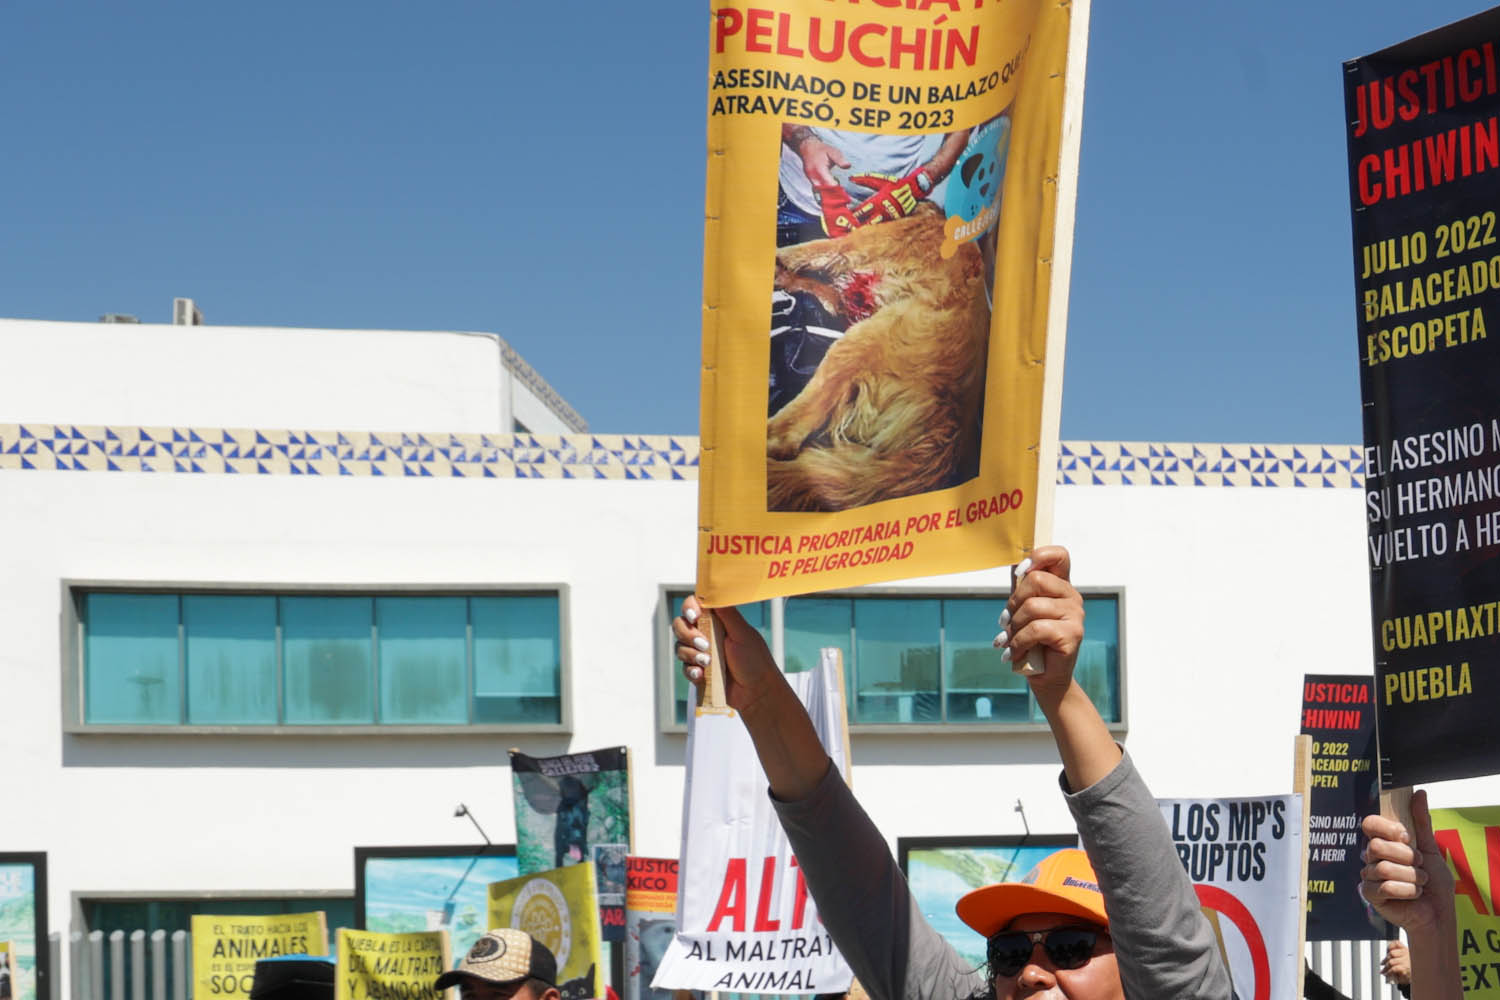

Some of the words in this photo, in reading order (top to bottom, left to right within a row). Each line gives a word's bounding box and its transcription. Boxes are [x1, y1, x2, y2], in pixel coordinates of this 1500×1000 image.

[715, 8, 980, 71] PELUCHÍN
[712, 69, 846, 99] ASESINADO
[852, 82, 881, 102] DE
[888, 85, 921, 105] UN
[927, 71, 999, 105] BALAZO
[712, 95, 841, 127] ATRAVESÓ,
[848, 107, 891, 129] SEP
[898, 109, 955, 130] 2023
[1362, 231, 1428, 280] JULIO
[1435, 210, 1497, 260] 2022
[1368, 306, 1488, 367] ESCOPETA
[1364, 445, 1386, 479] EL
[1390, 423, 1485, 473] ASESINO
[706, 534, 793, 556] JUSTICIA
[797, 520, 902, 554] PRIORITARIA
[904, 511, 941, 537] POR
[945, 508, 963, 530] EL
[965, 487, 1025, 524] GRADO
[1367, 487, 1391, 523] SU
[767, 560, 790, 580] DE
[792, 540, 914, 577] PELIGROSIDAD
[1369, 522, 1448, 567] VUELTO
[1455, 518, 1470, 553] A
[1304, 682, 1369, 705] USTICIA
[1385, 661, 1473, 706] PUEBLA
[1322, 742, 1350, 756] 2022
[1351, 759, 1371, 772] CON
[1172, 802, 1221, 842] LOS
[1228, 799, 1286, 842] MP'S
[1332, 812, 1357, 829] MATÓ
[1312, 848, 1319, 862] A
[1320, 849, 1346, 862] HERIR
[1339, 833, 1346, 845] Y
[1345, 833, 1357, 846] HA
[706, 855, 812, 933] ALT
[212, 935, 308, 958] ANIMALES
[685, 940, 717, 963] AL
[1461, 929, 1480, 955] A
[374, 955, 443, 976] MALTRATO
[713, 967, 816, 991] ANIMAL
[348, 978, 358, 999] Y
